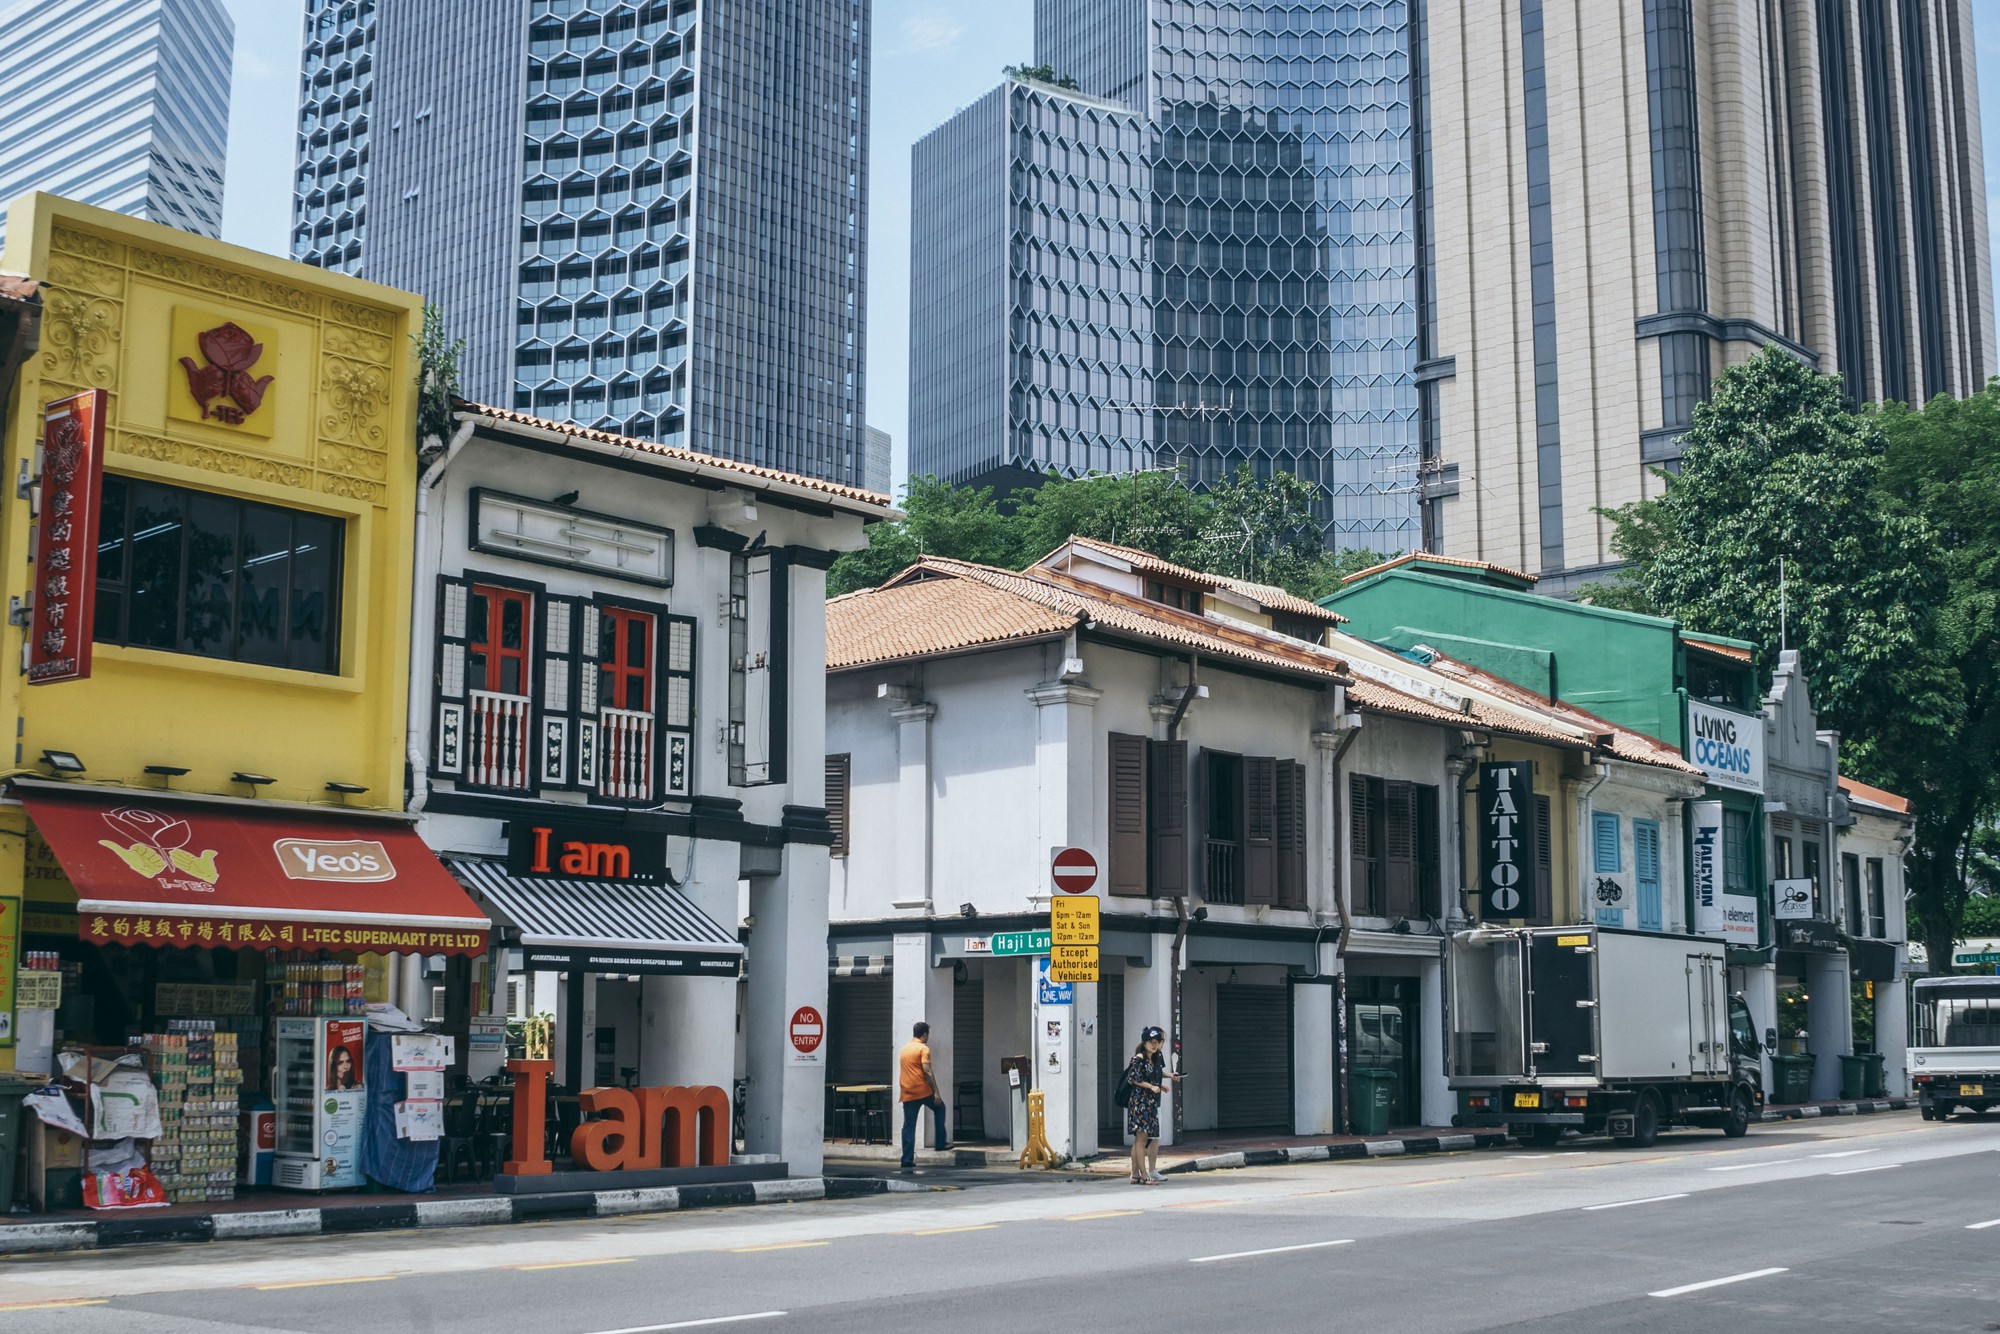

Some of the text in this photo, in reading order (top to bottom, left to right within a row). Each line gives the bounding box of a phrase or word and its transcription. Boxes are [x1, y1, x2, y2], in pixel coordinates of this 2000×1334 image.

[201, 401, 246, 425] I-TEC
[1693, 711, 1737, 745] LIVING
[1695, 738, 1751, 775] OCEANS
[1489, 767, 1520, 911] TATTOO
[530, 827, 553, 873] I
[292, 847, 381, 873] Yeo's
[1693, 826, 1719, 907] HALCYON
[157, 877, 216, 893] I-TEC
[1694, 869, 1702, 900] Systems
[1056, 900, 1065, 908] Fri
[1056, 911, 1070, 920] 6pm
[1075, 911, 1092, 919] 12am
[1728, 906, 1755, 923] element
[1056, 922, 1068, 930] Sat
[1078, 922, 1091, 930] Sun
[302, 927, 480, 948] I-TEC SUPERMART PTE LTD
[967, 940, 986, 950] I am
[997, 935, 1051, 953] Haji Lan
[1057, 933, 1073, 942] 12pm
[1078, 933, 1095, 941] 12am
[1060, 948, 1089, 959] Except
[1959, 955, 1977, 963] Bali
[1052, 959, 1098, 969] Authorised
[1058, 971, 1092, 980] Vehicles
[1042, 990, 1073, 1000] ONE WAY
[800, 1013, 814, 1023] NO
[794, 1036, 819, 1045] ENTRY
[503, 1059, 730, 1175] I am
